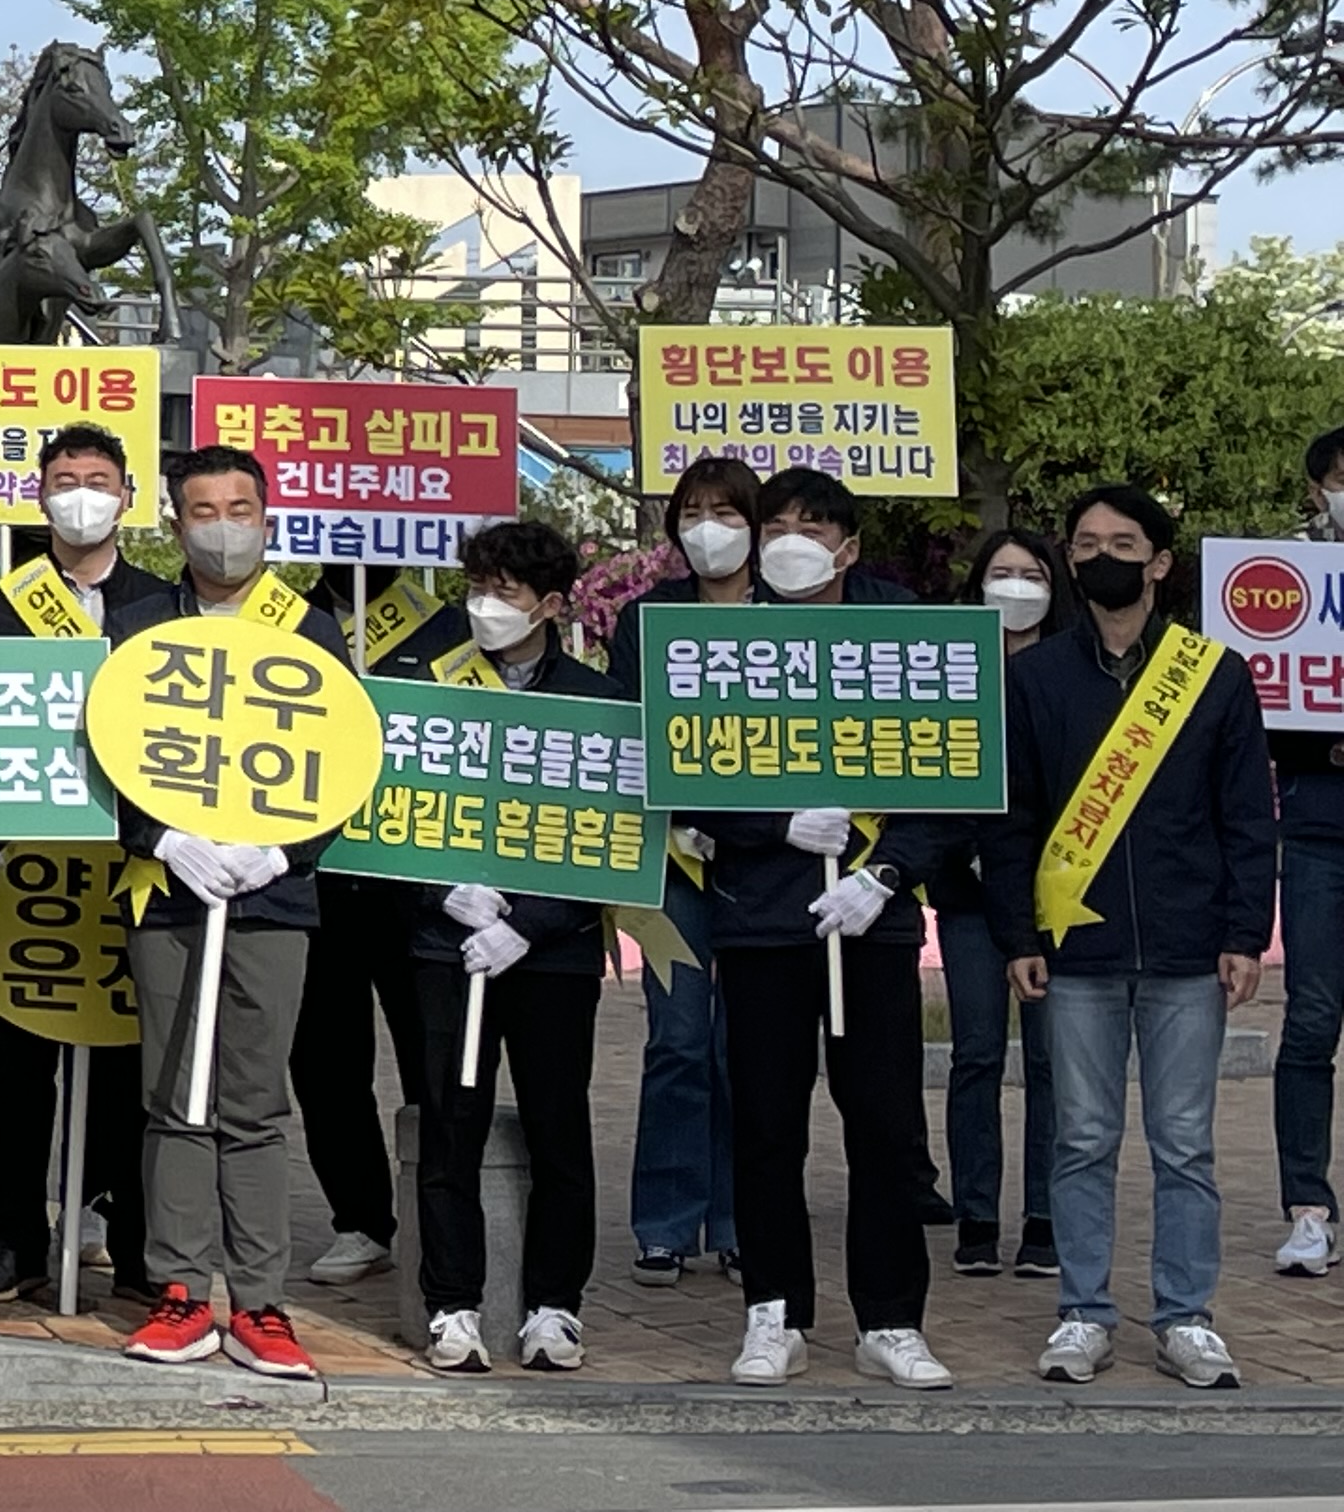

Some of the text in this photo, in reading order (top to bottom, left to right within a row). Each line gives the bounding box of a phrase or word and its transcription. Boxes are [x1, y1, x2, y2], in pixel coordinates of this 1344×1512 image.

[53, 367, 137, 412] 이용
[662, 345, 931, 387] 횡단보도 이용
[215, 403, 501, 457] 멈추고 살피고
[675, 402, 919, 435] 나의 생명을 지키는
[277, 461, 453, 501] 건너주세요
[787, 444, 934, 478] 약속입니다
[1231, 586, 1302, 610] STOP
[144, 640, 327, 732] 좌우
[666, 639, 979, 701] 음주운전 흔들흔들
[1248, 652, 1344, 714] 일단
[139, 726, 321, 823] 확인
[384, 713, 644, 796] 주운전 흔들흔들
[667, 715, 980, 778] 인생길도 흔들흔들
[496, 800, 644, 871] 흔들흔들
[6, 853, 125, 927] 양
